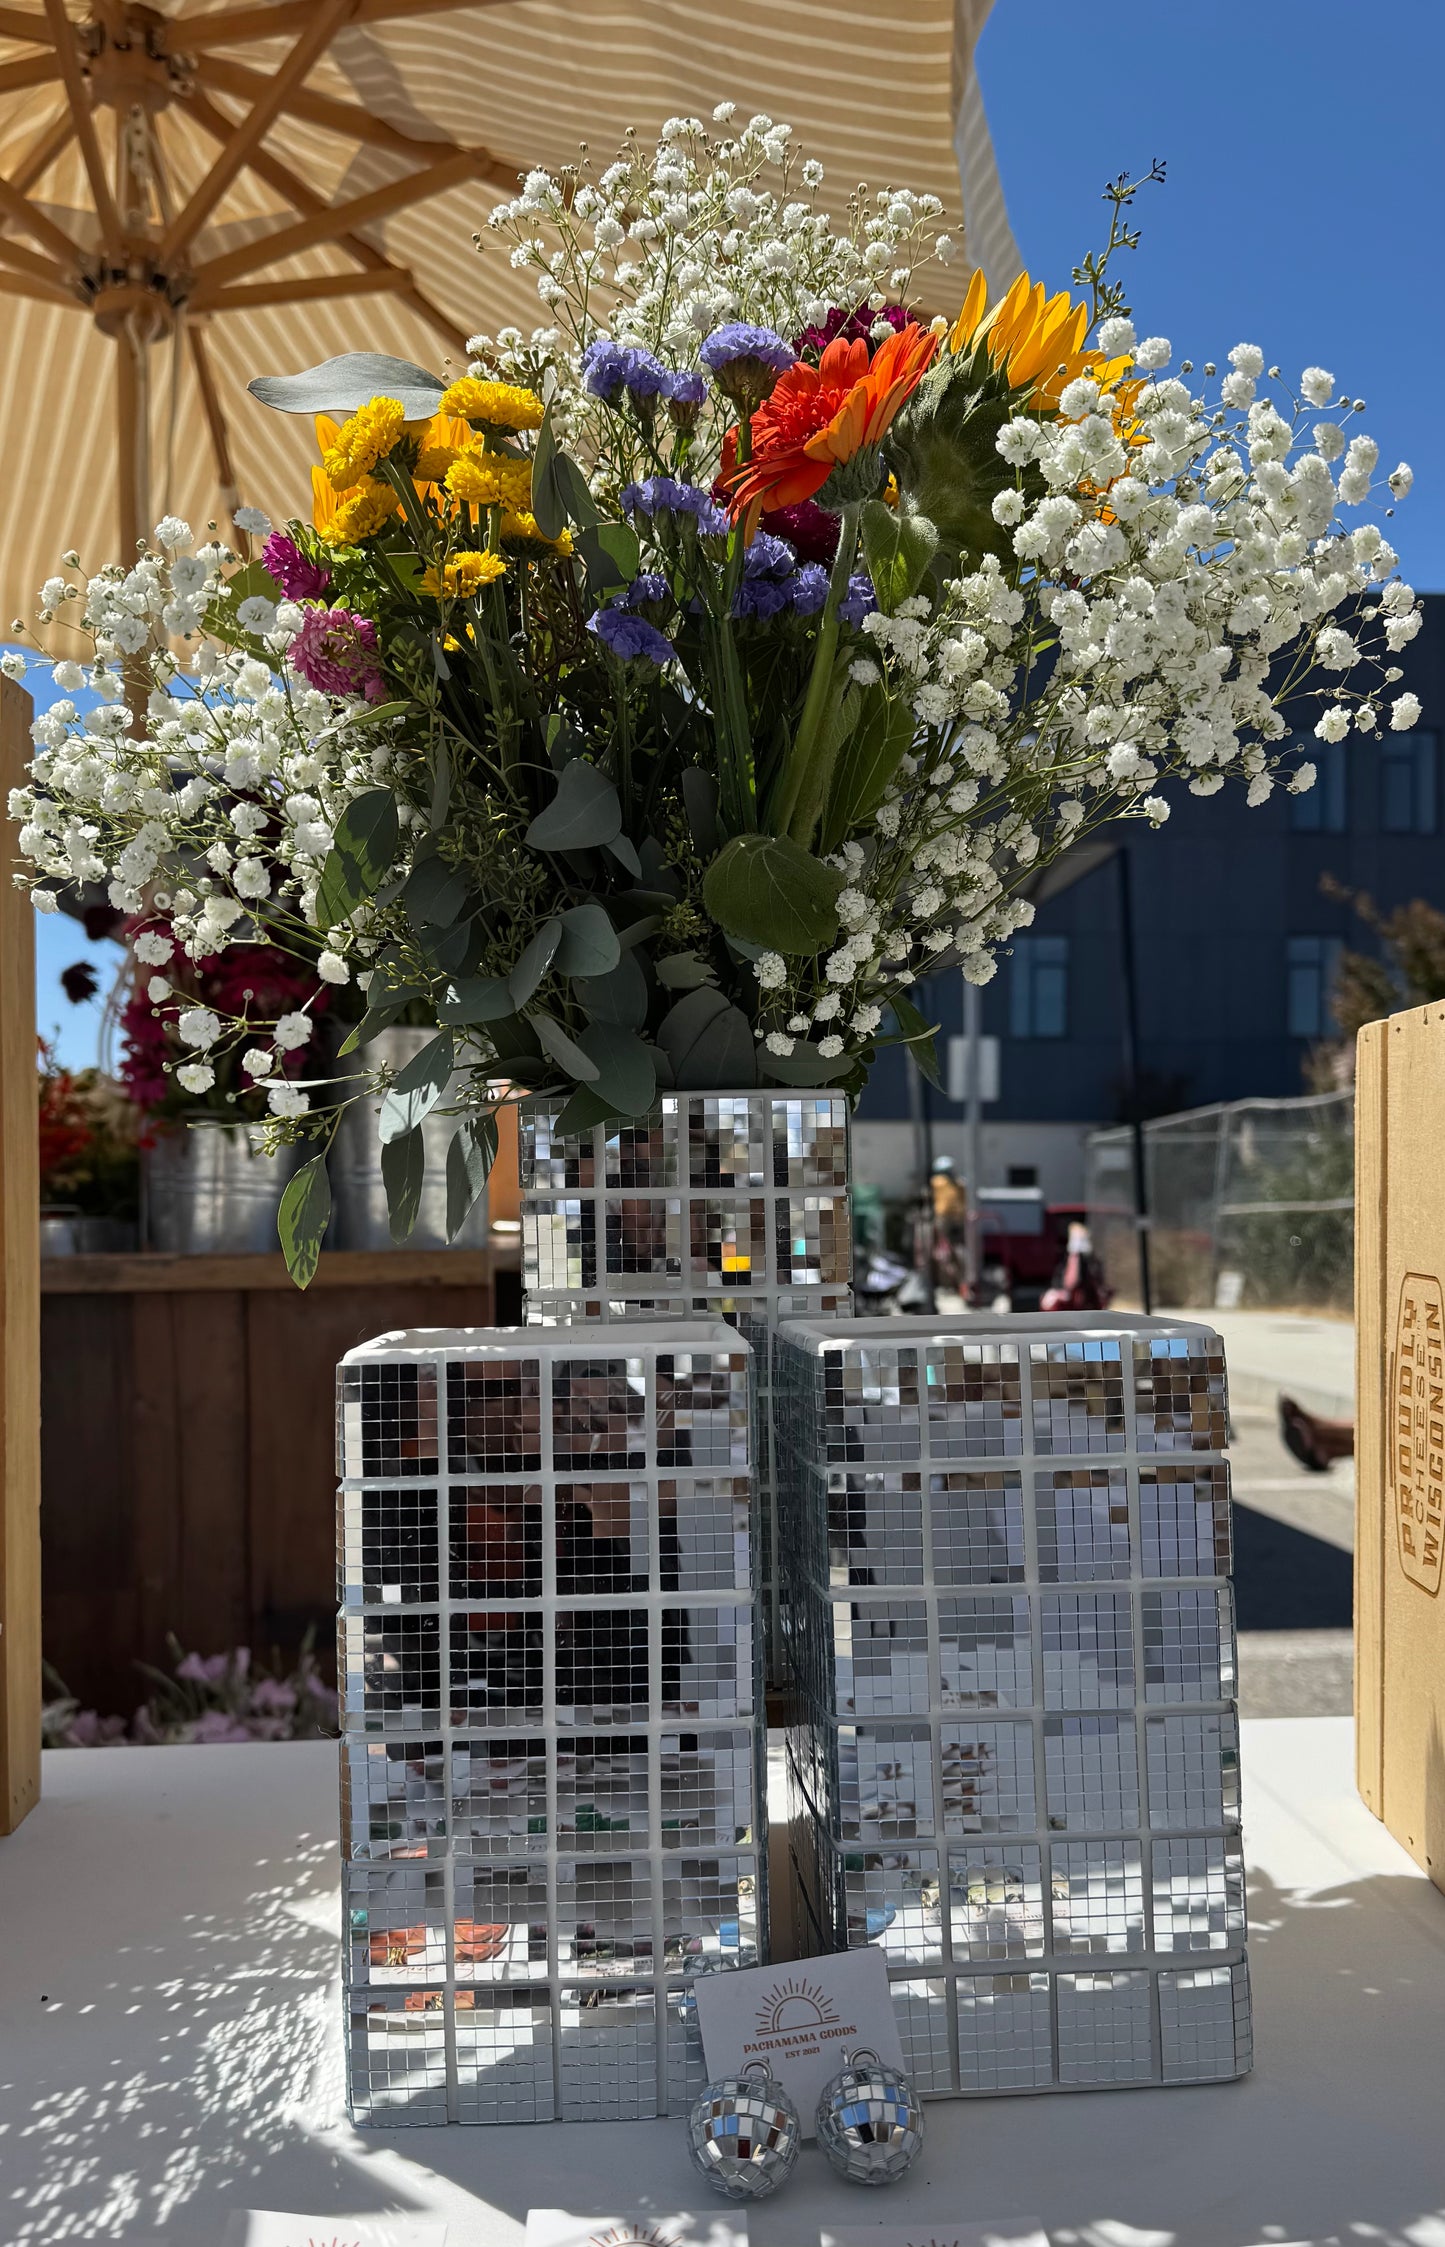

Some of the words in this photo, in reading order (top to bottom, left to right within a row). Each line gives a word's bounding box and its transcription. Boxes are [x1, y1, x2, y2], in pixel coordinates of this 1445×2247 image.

[1399, 1297, 1417, 1559] PROUDLY
[1415, 1343, 1425, 1525] CHEESE
[1423, 1301, 1444, 1568] WISCONSIN
[743, 2032, 817, 2054] PACHAMAMA
[819, 2025, 857, 2040] GOODS
[785, 2049, 800, 2059] EST
[802, 2046, 820, 2056] 2021
